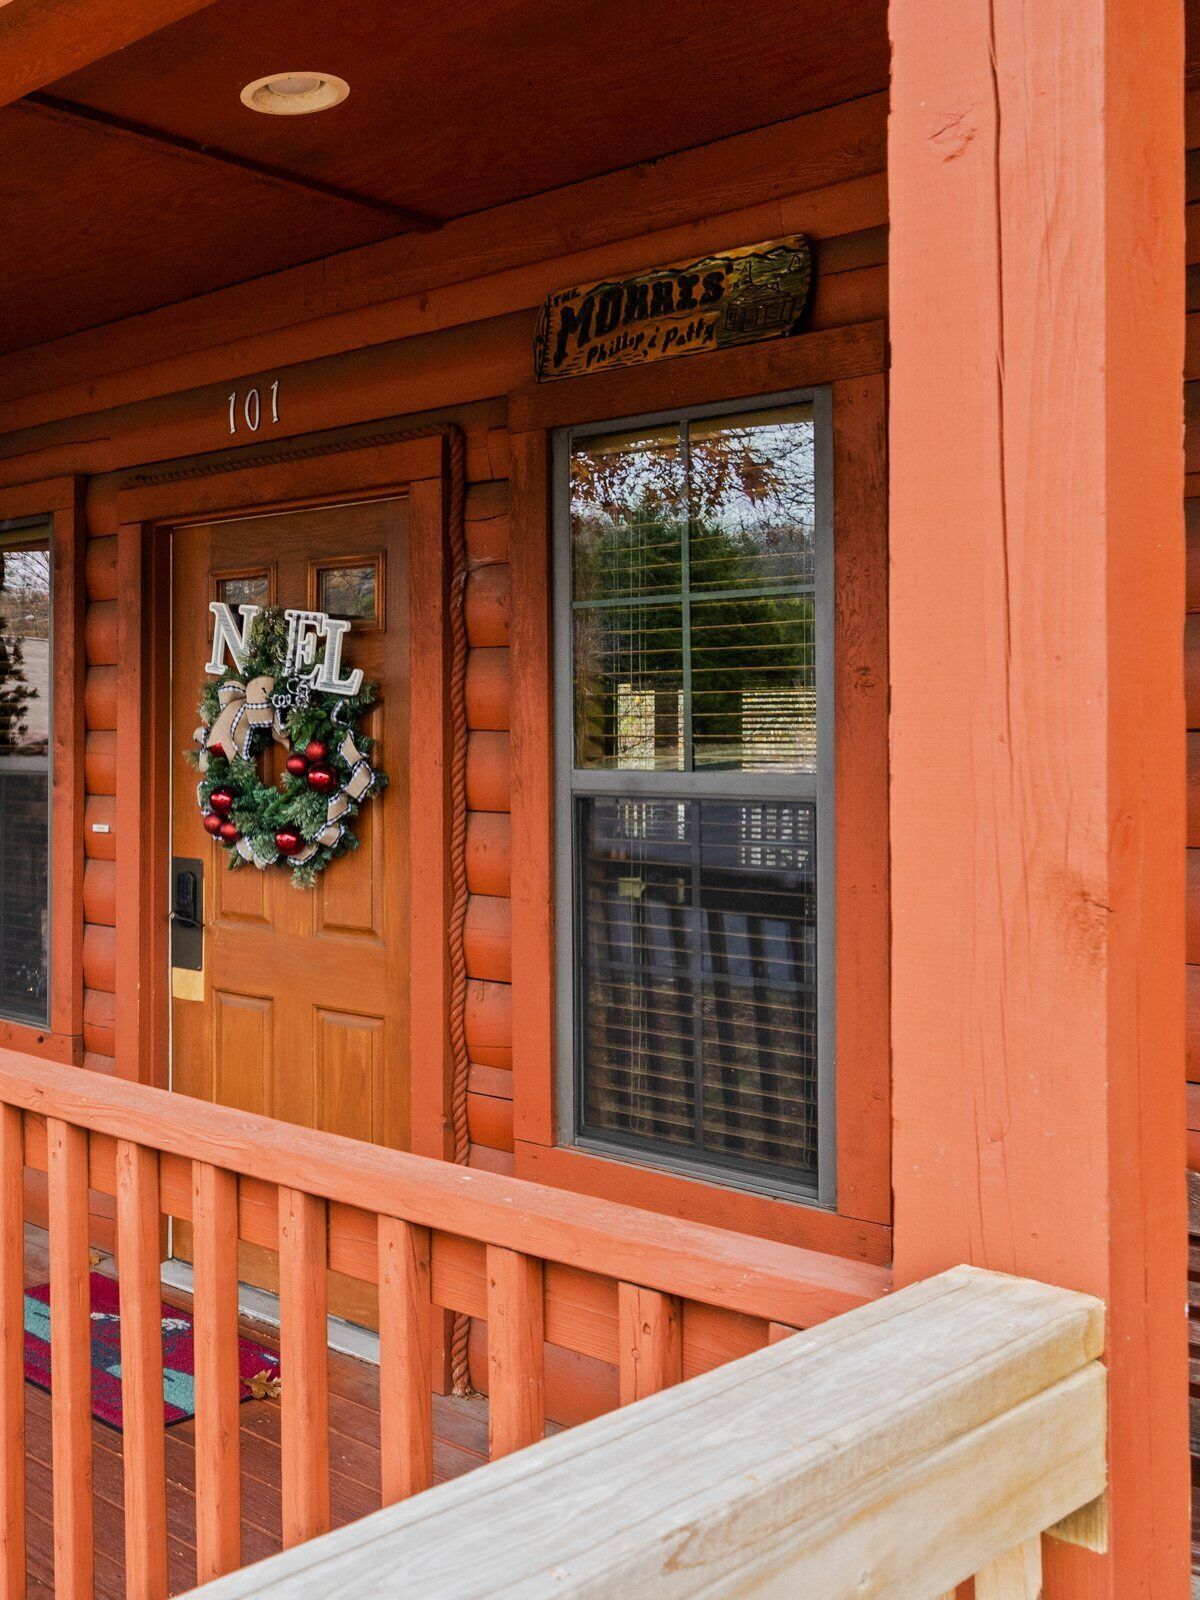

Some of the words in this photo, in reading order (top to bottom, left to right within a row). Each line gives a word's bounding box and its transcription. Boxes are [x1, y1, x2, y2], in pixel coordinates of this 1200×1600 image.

[552, 286, 581, 307] THE
[661, 317, 718, 353] Patty
[228, 380, 279, 434] 101
[205, 601, 364, 696] NEL
